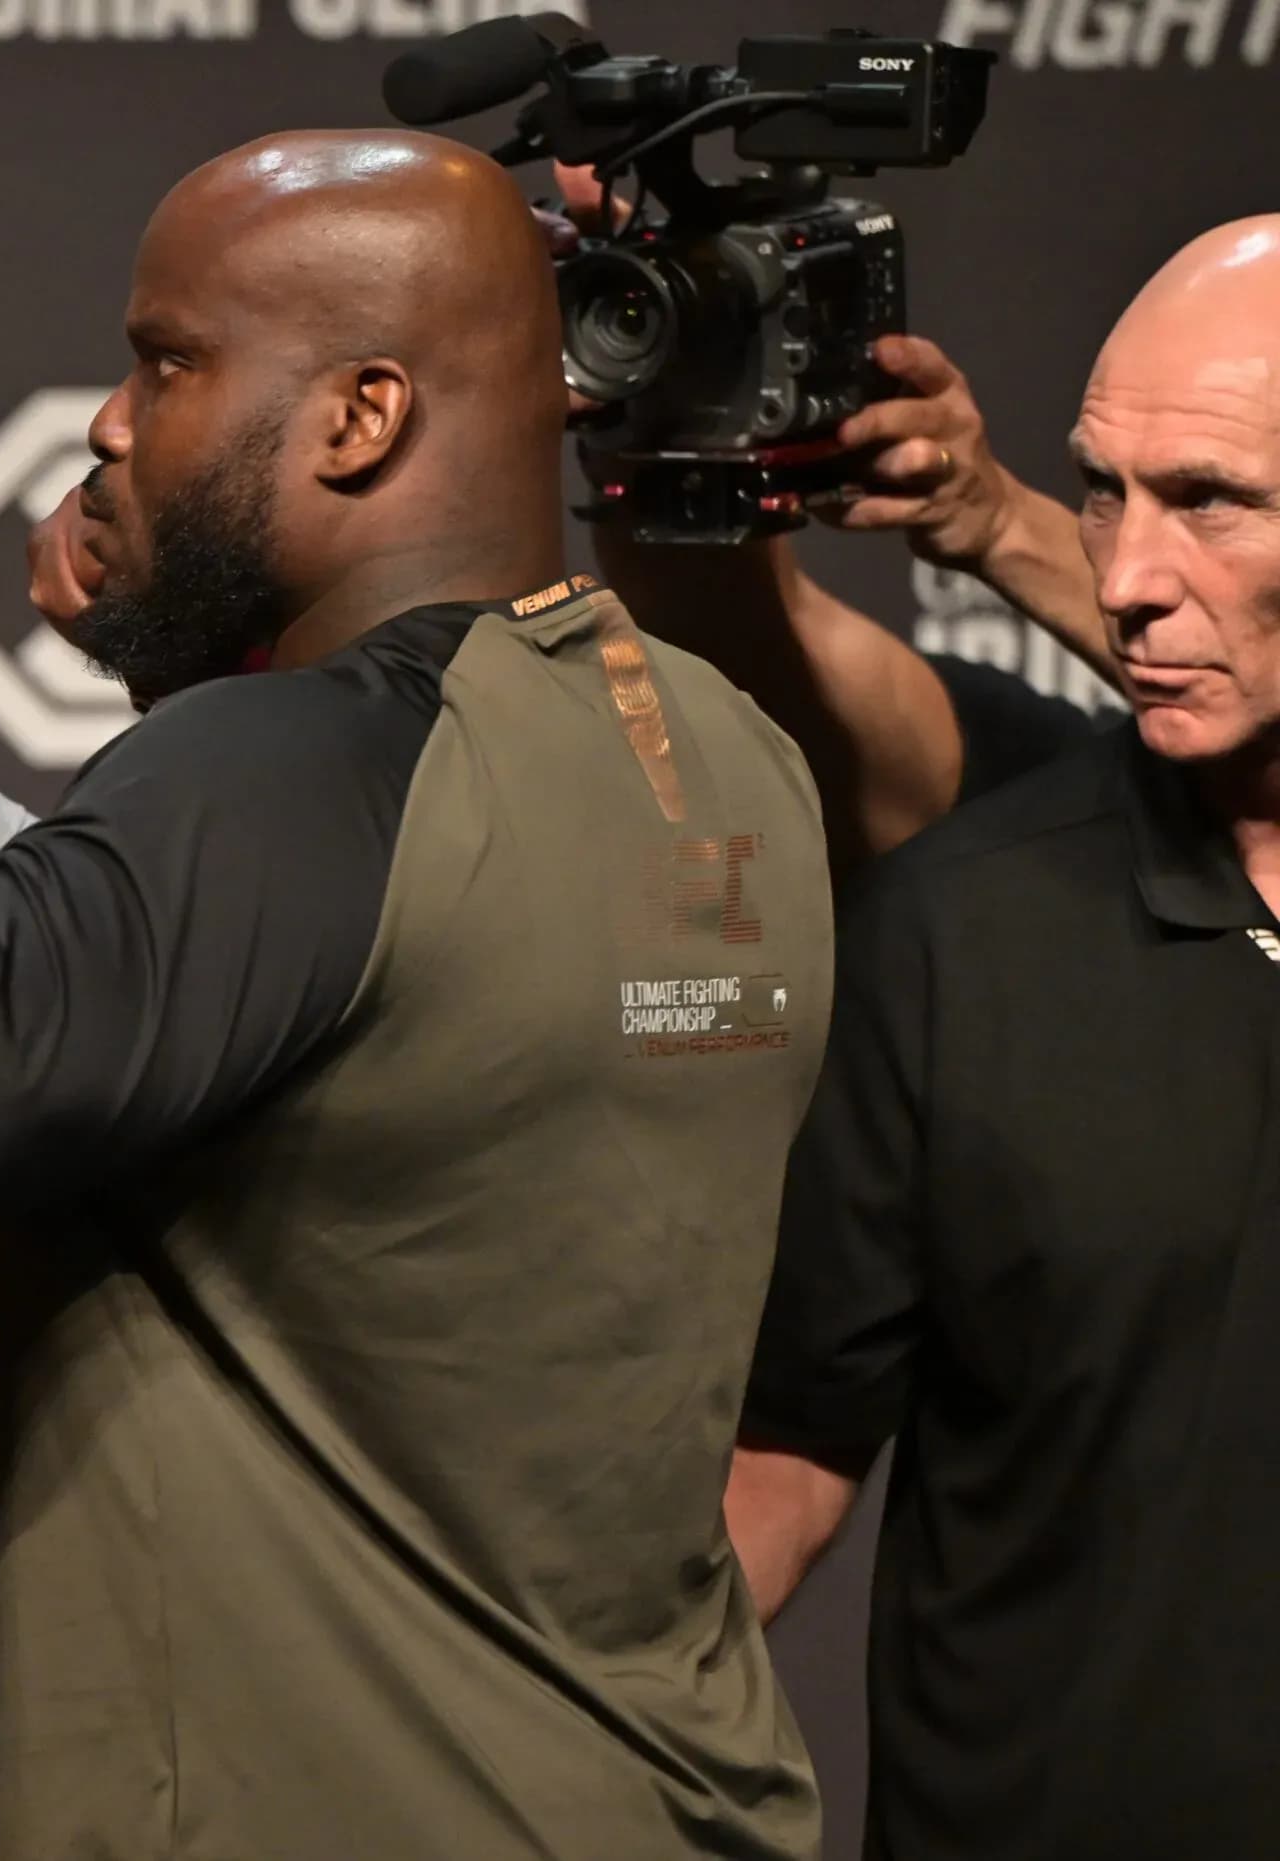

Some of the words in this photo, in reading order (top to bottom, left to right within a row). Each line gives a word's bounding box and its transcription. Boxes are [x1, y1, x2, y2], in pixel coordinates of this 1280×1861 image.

[858, 57, 915, 71] SONY
[856, 214, 895, 235] SONY
[511, 581, 571, 617] VENUM
[620, 981, 681, 1007] ULTIMATE
[683, 977, 741, 1005] FIGHTING
[621, 1006, 717, 1034] CHAMPIONSHIP
